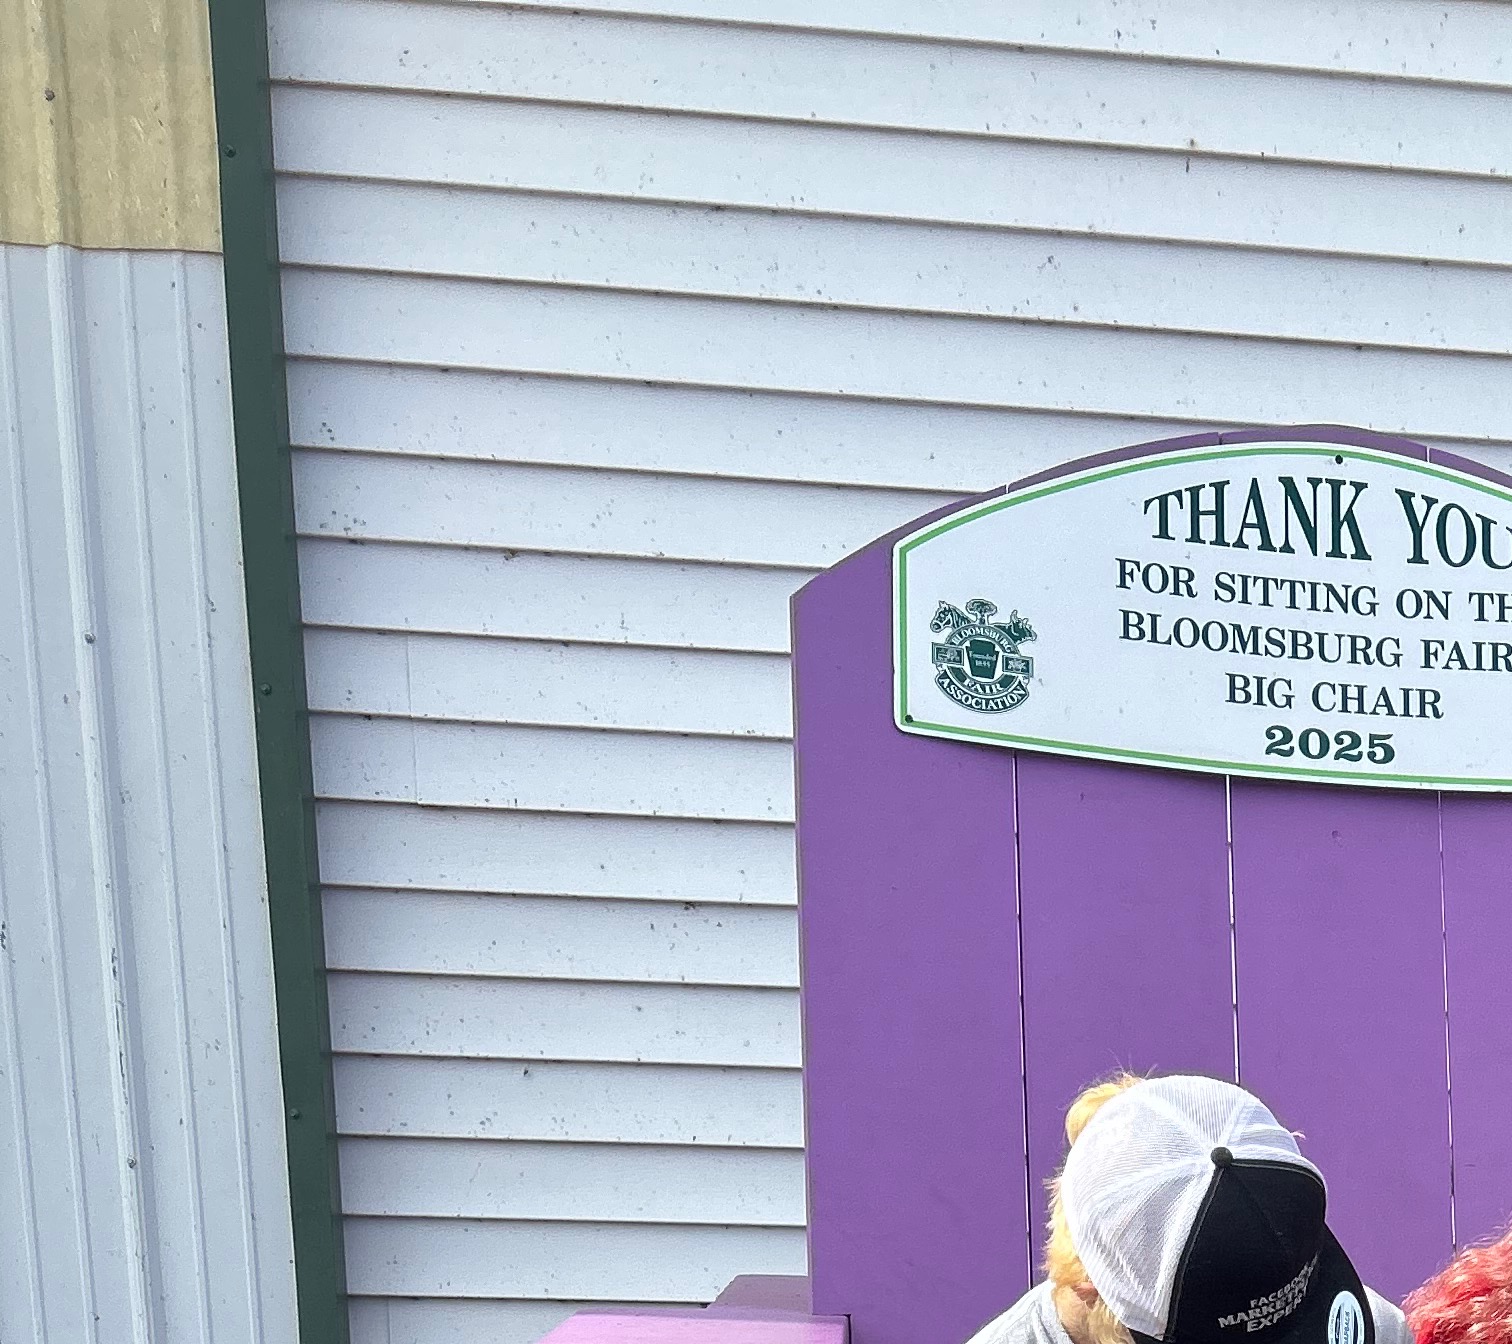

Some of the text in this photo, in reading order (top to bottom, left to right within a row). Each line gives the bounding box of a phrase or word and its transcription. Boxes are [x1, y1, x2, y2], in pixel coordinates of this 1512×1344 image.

[1144, 476, 1372, 561] THANK
[1115, 558, 1198, 598] FOR
[1214, 571, 1379, 617] SITTING
[1395, 588, 1452, 620] ON
[951, 626, 1013, 653] BLOOMSBURG
[1119, 609, 1403, 668] BLOOMSBURG
[939, 679, 1026, 710] ASSOCIATION
[964, 679, 1004, 694] FAIR
[1225, 672, 1445, 720] BIG CHAIR
[1264, 725, 1396, 765] 2025
